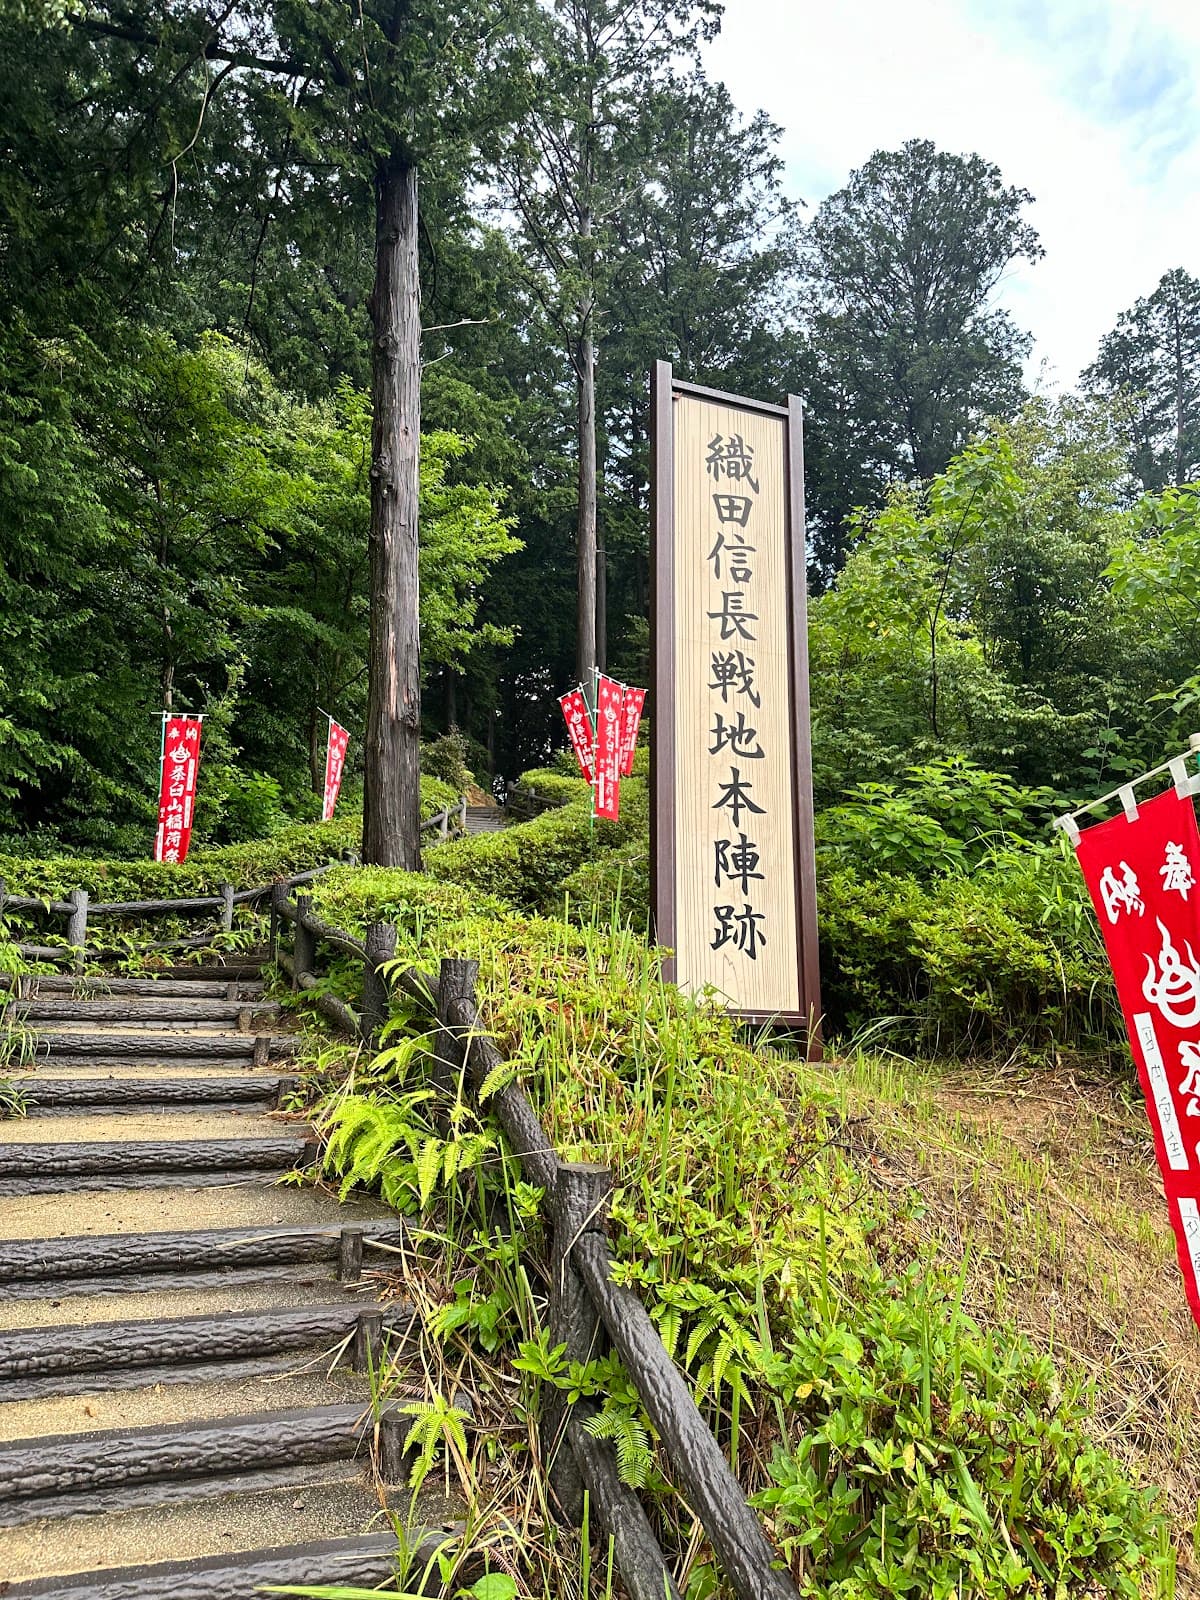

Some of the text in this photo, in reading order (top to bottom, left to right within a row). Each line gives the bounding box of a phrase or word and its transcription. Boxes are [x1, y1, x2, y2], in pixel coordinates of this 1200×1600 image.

[705, 433, 768, 961] 織田信長戦地本陣跡
